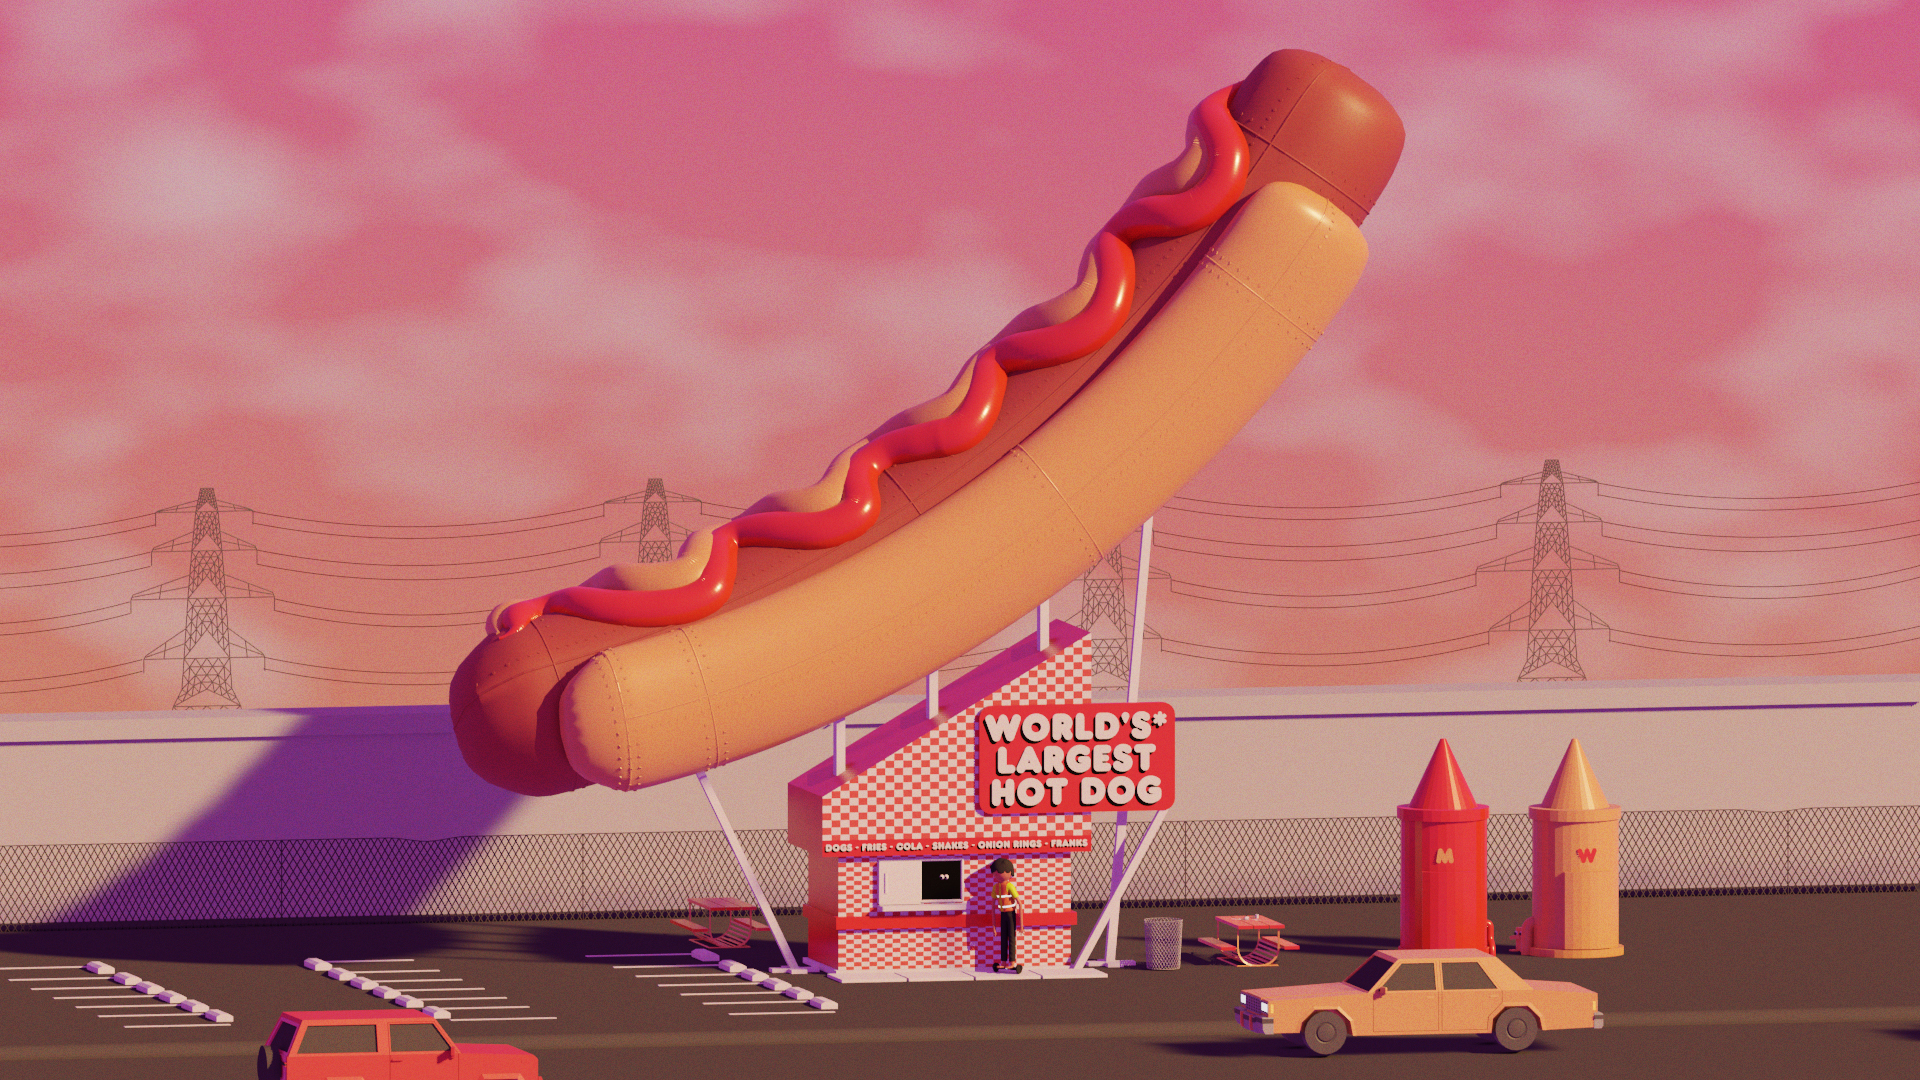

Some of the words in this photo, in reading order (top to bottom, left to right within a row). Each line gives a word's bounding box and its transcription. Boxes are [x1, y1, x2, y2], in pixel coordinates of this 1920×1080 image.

[996, 743, 1156, 776] LARGEST
[990, 777, 1069, 808] HOT
[1080, 775, 1162, 807] DOG
[825, 843, 853, 853] DOGS
[861, 842, 887, 852] FRIES
[895, 842, 923, 851] COLA
[931, 841, 969, 851] SHAKES
[977, 840, 1010, 850] ONION
[1012, 840, 1042, 849] RINGS
[1050, 838, 1088, 848] FRANKS
[1435, 848, 1454, 864] M
[1577, 848, 1597, 863] W
